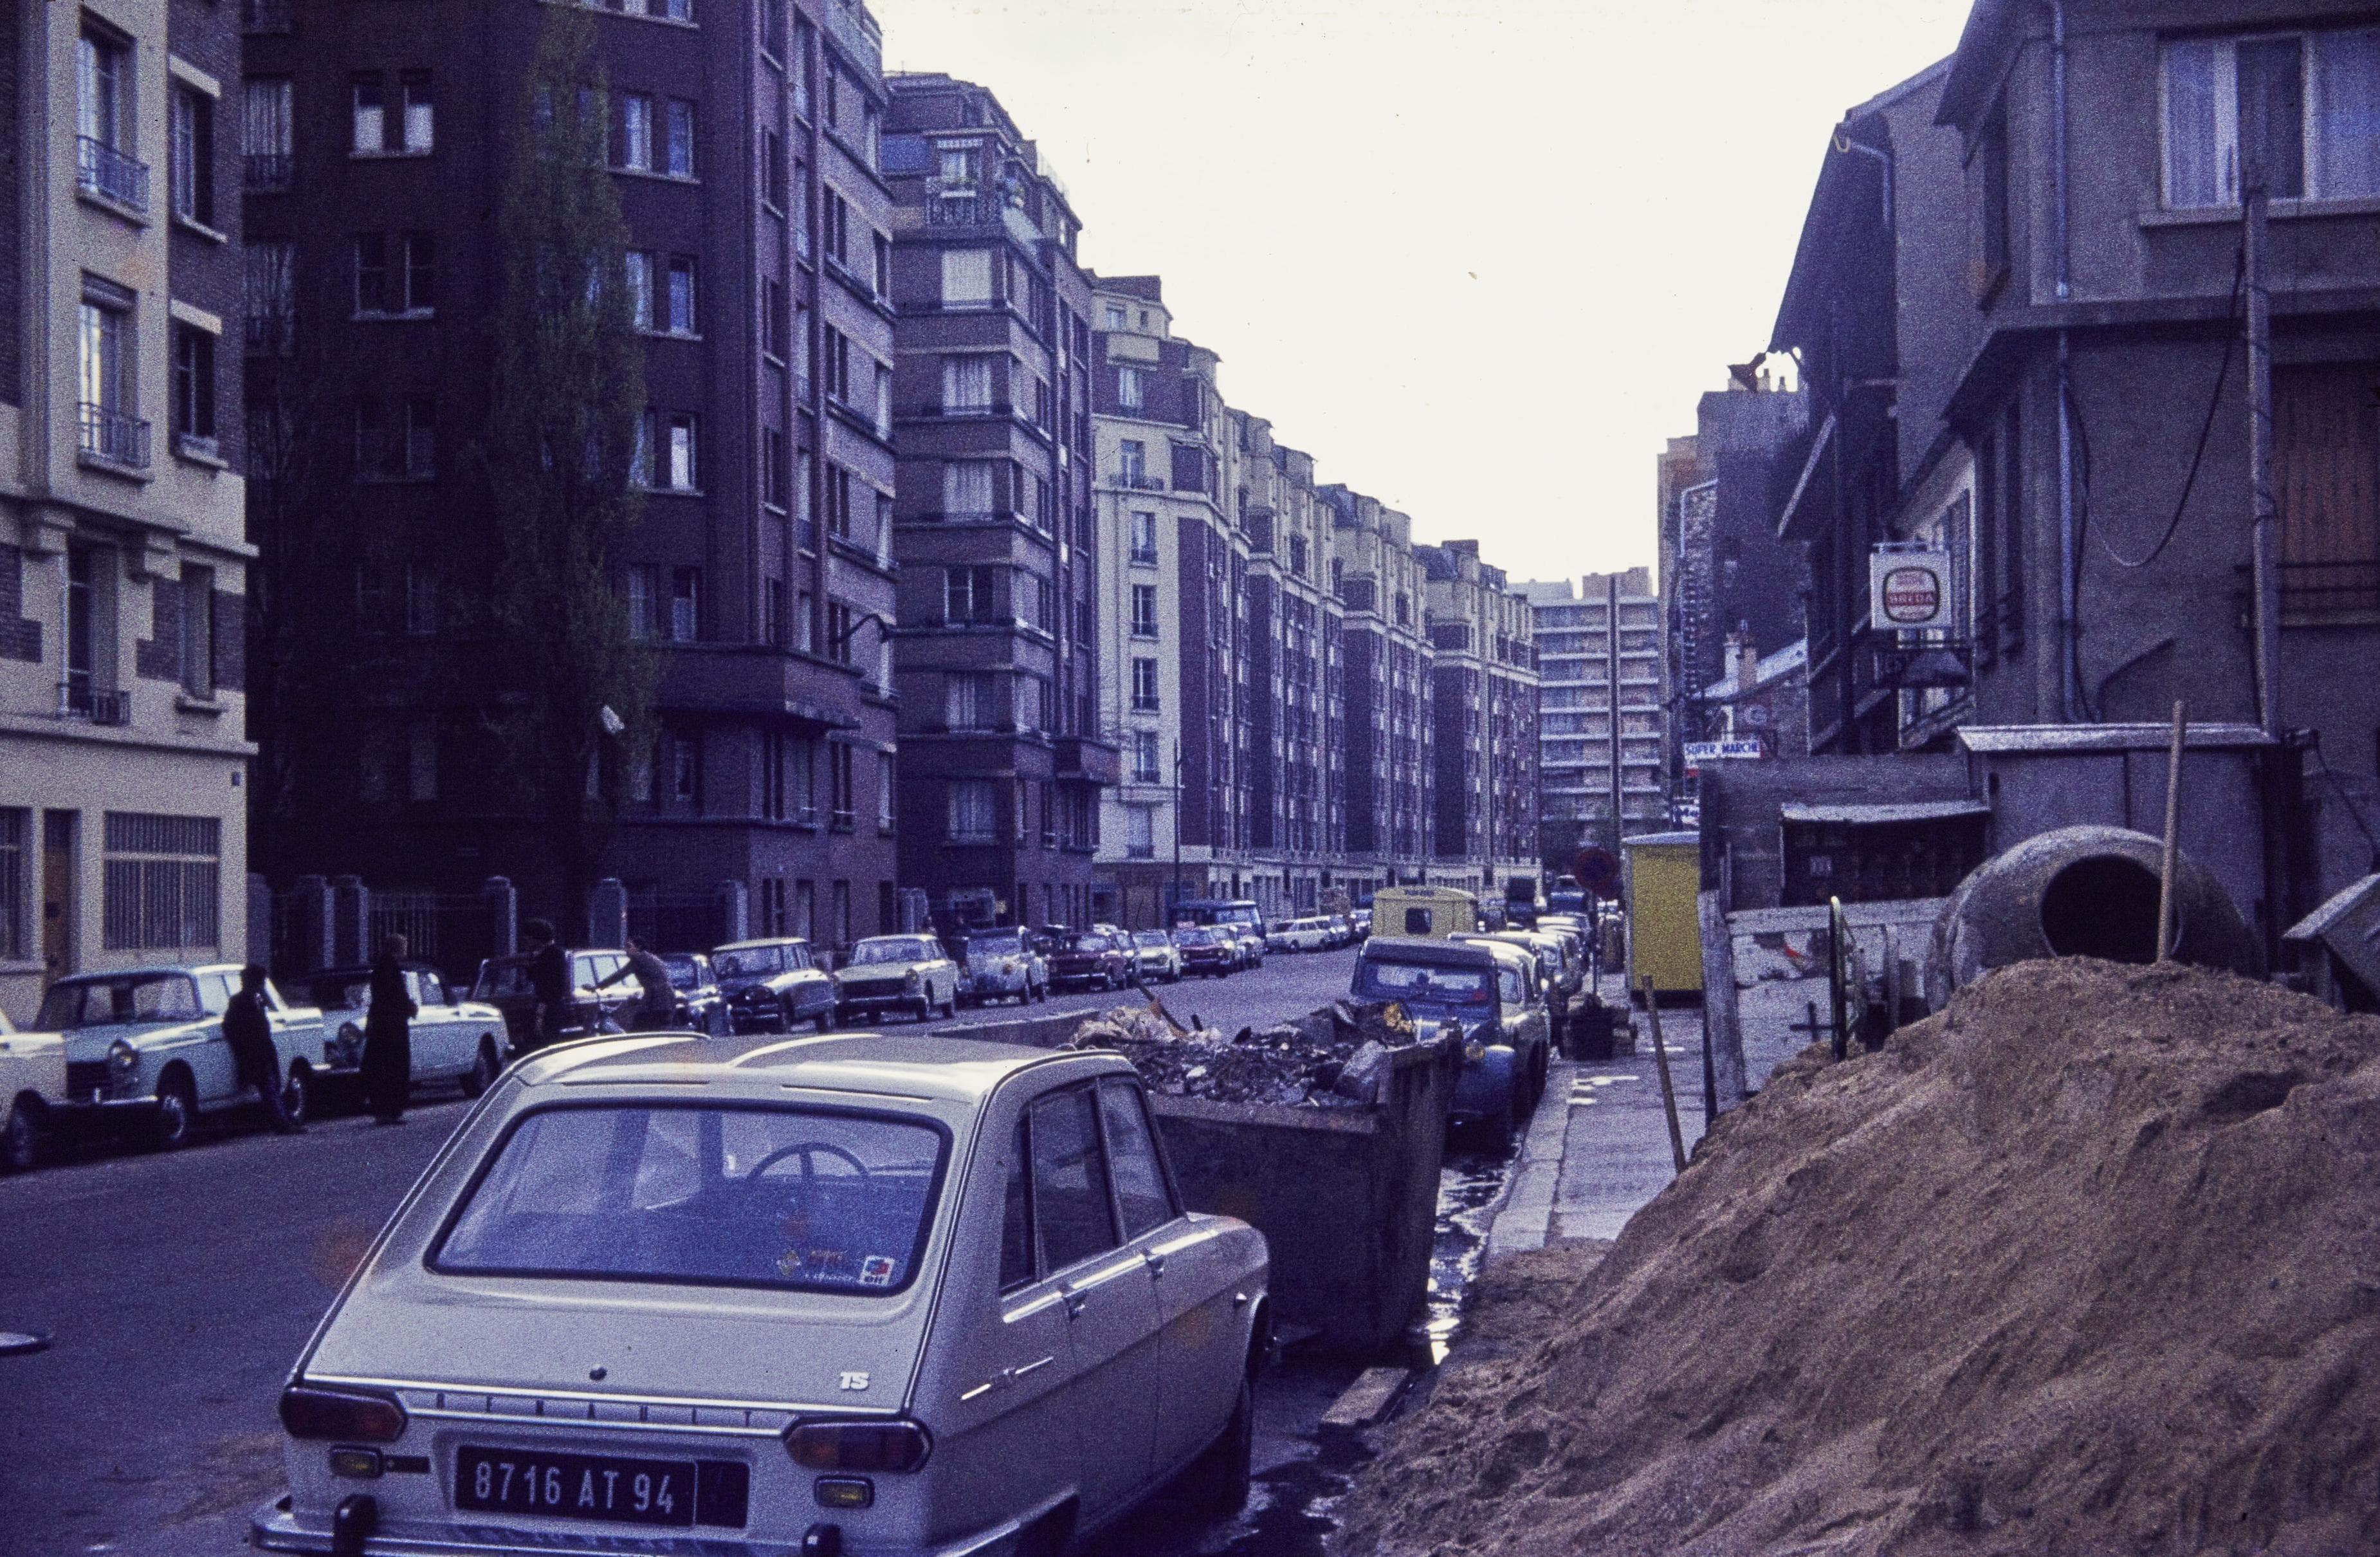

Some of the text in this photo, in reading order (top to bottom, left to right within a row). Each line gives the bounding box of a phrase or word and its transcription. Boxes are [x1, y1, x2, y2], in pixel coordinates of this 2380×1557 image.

[840, 1371, 870, 1390] TS
[475, 1461, 674, 1515] 8716 AT 94
